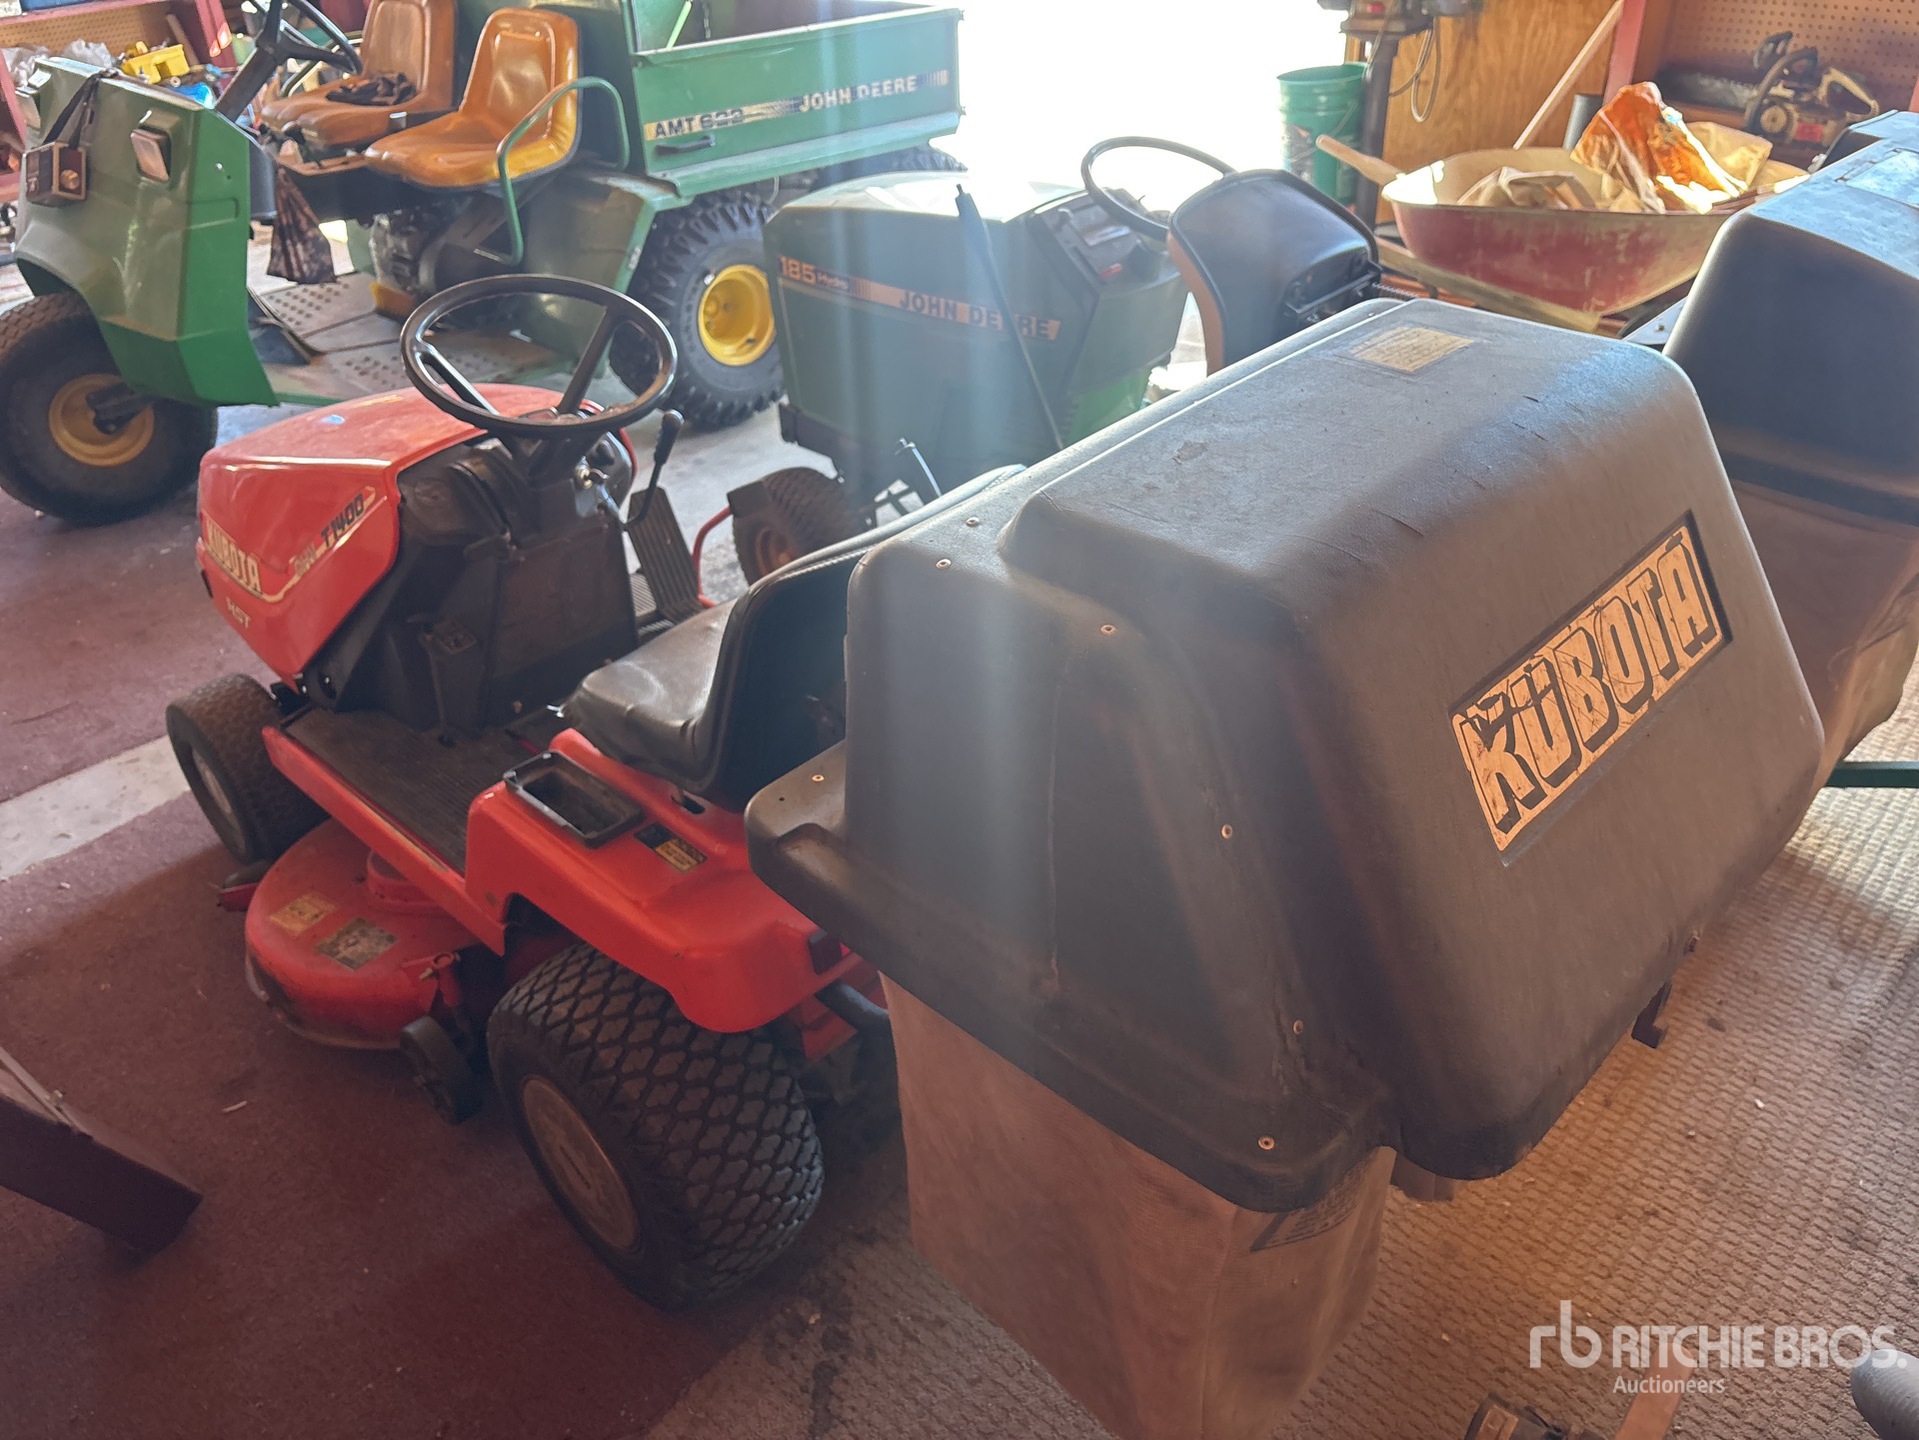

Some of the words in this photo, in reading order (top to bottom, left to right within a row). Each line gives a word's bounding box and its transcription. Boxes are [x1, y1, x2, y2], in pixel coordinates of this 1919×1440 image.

[799, 87, 852, 112] JOHN
[857, 75, 918, 99] DEERE
[655, 118, 695, 138] AMT
[779, 255, 816, 285] 185
[899, 290, 958, 321] JOHN
[968, 303, 1050, 338] DERE
[1458, 530, 1719, 836] KUBOTA
